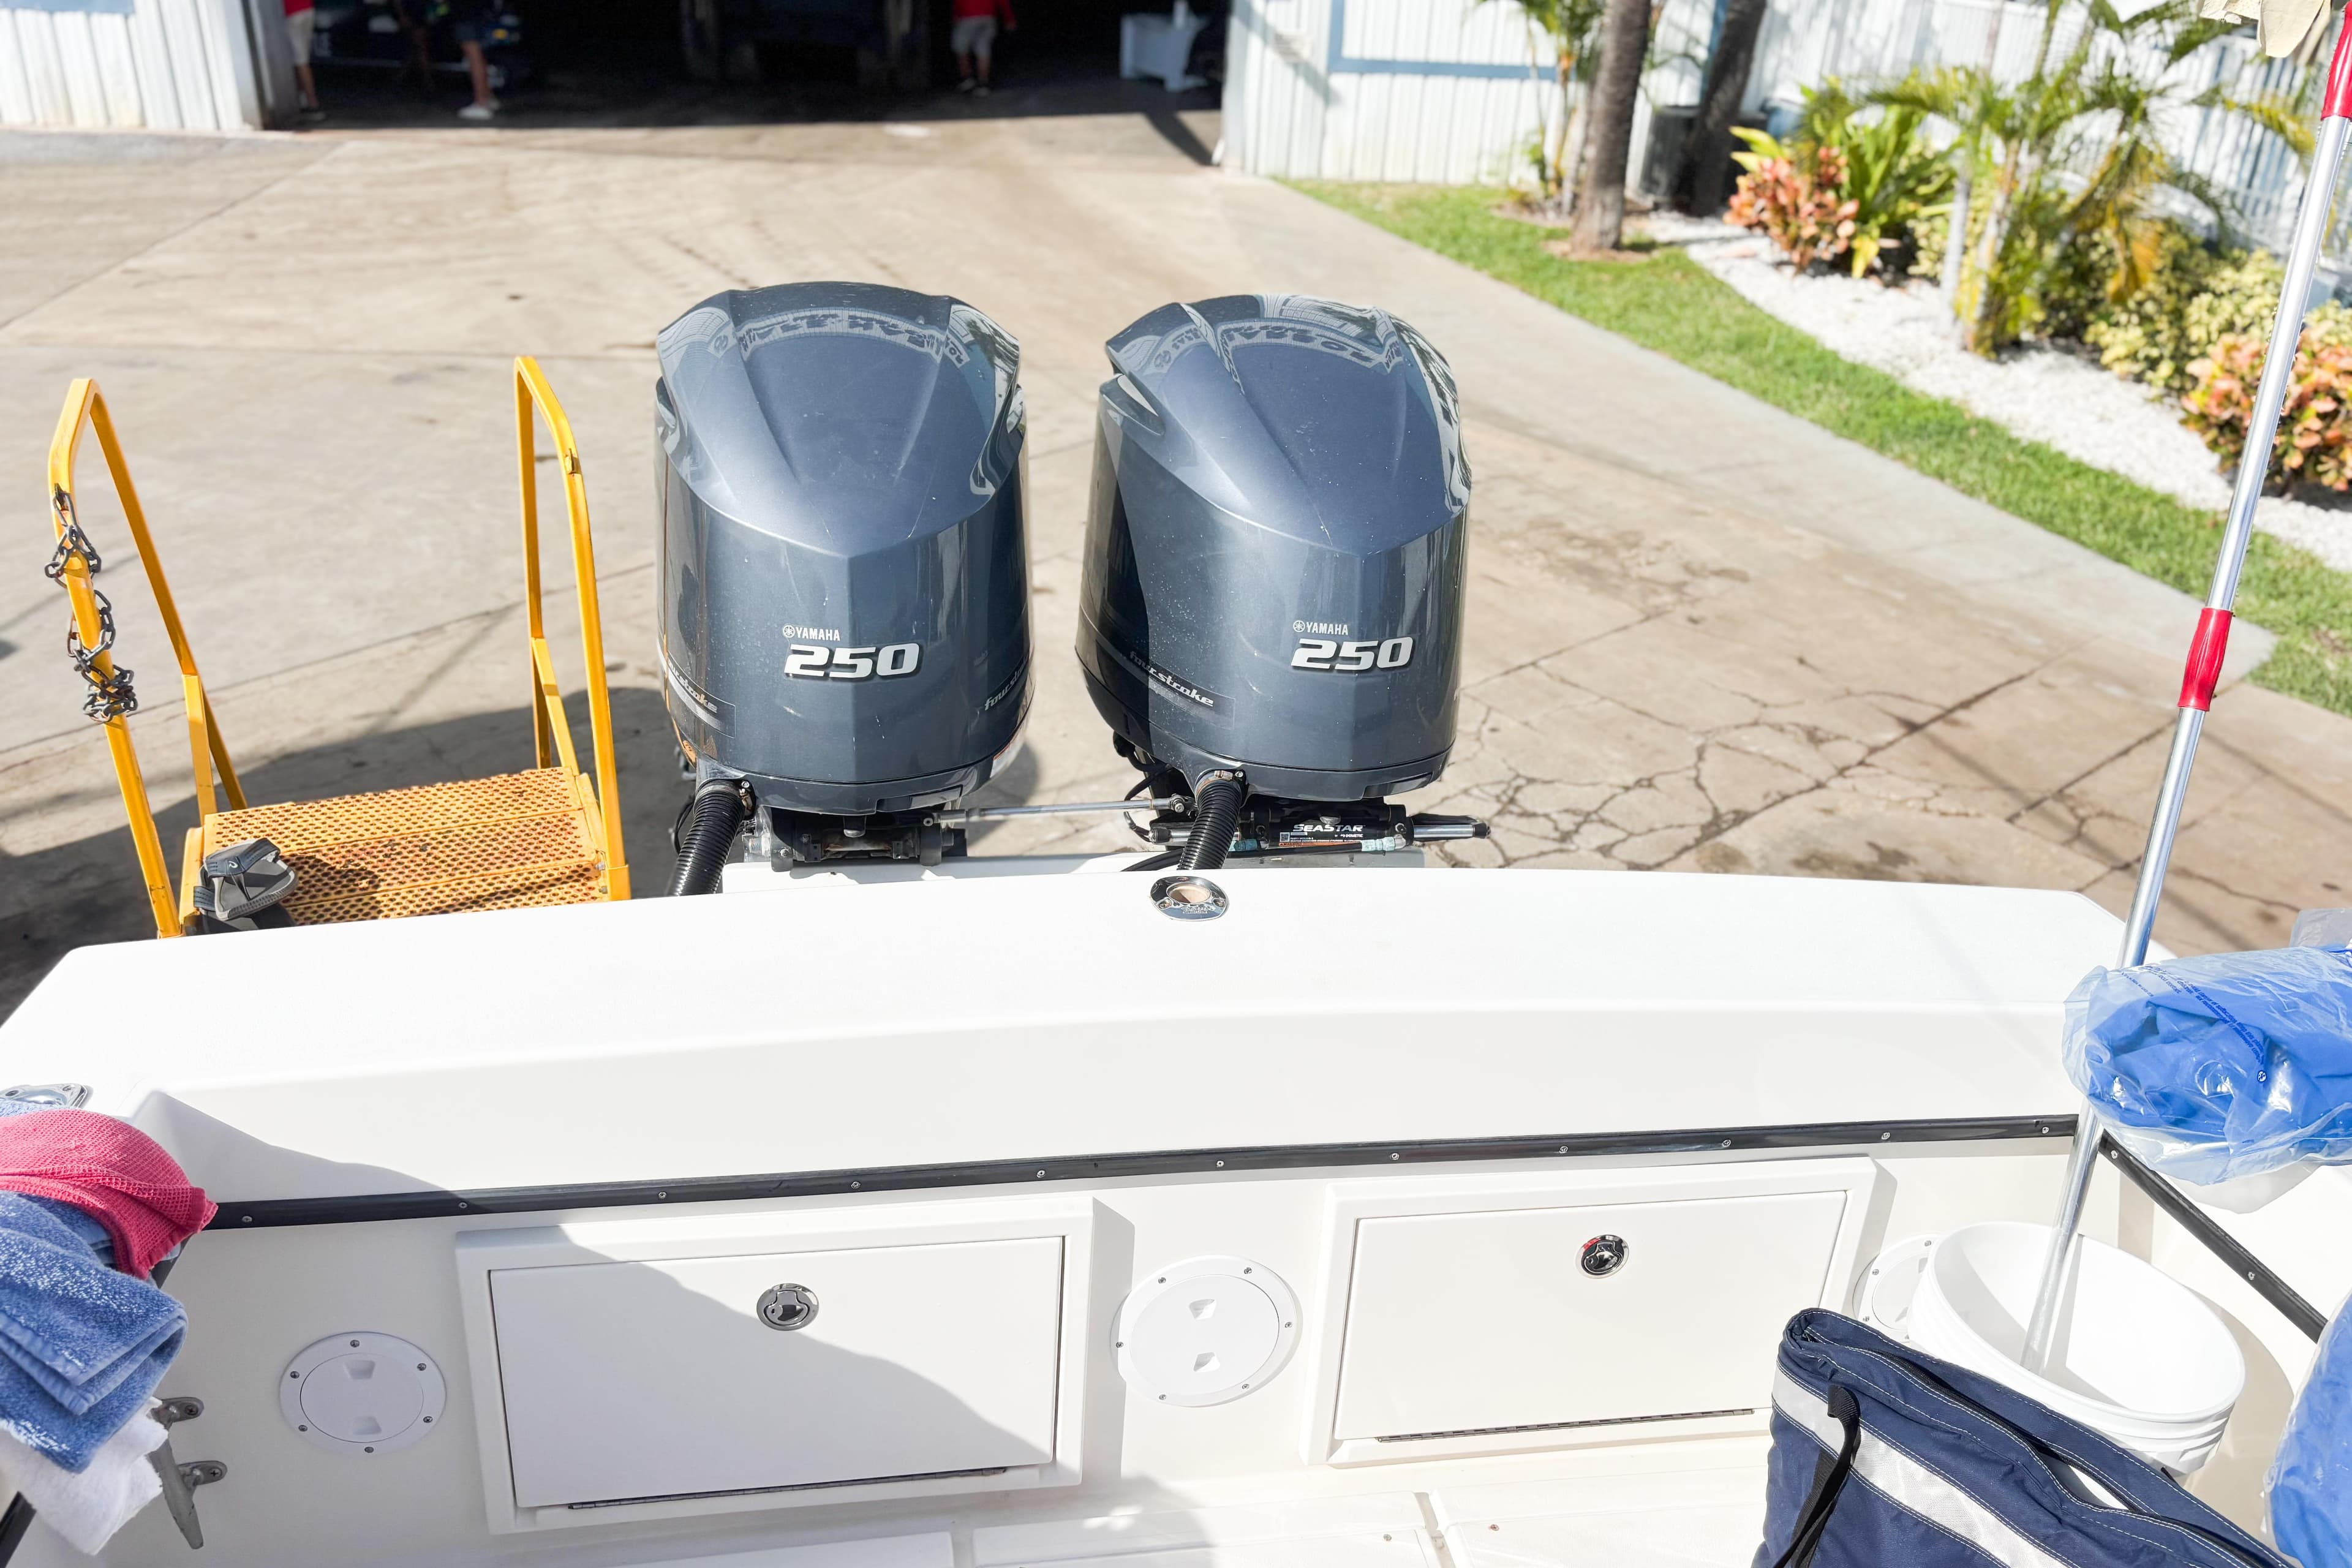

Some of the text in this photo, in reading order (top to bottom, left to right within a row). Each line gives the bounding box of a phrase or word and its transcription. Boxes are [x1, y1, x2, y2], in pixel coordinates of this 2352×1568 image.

[796, 627, 840, 641] YAMAHA
[1306, 622, 1349, 636] YAMAHA
[783, 643, 920, 679] 250
[1291, 636, 1414, 671] 250
